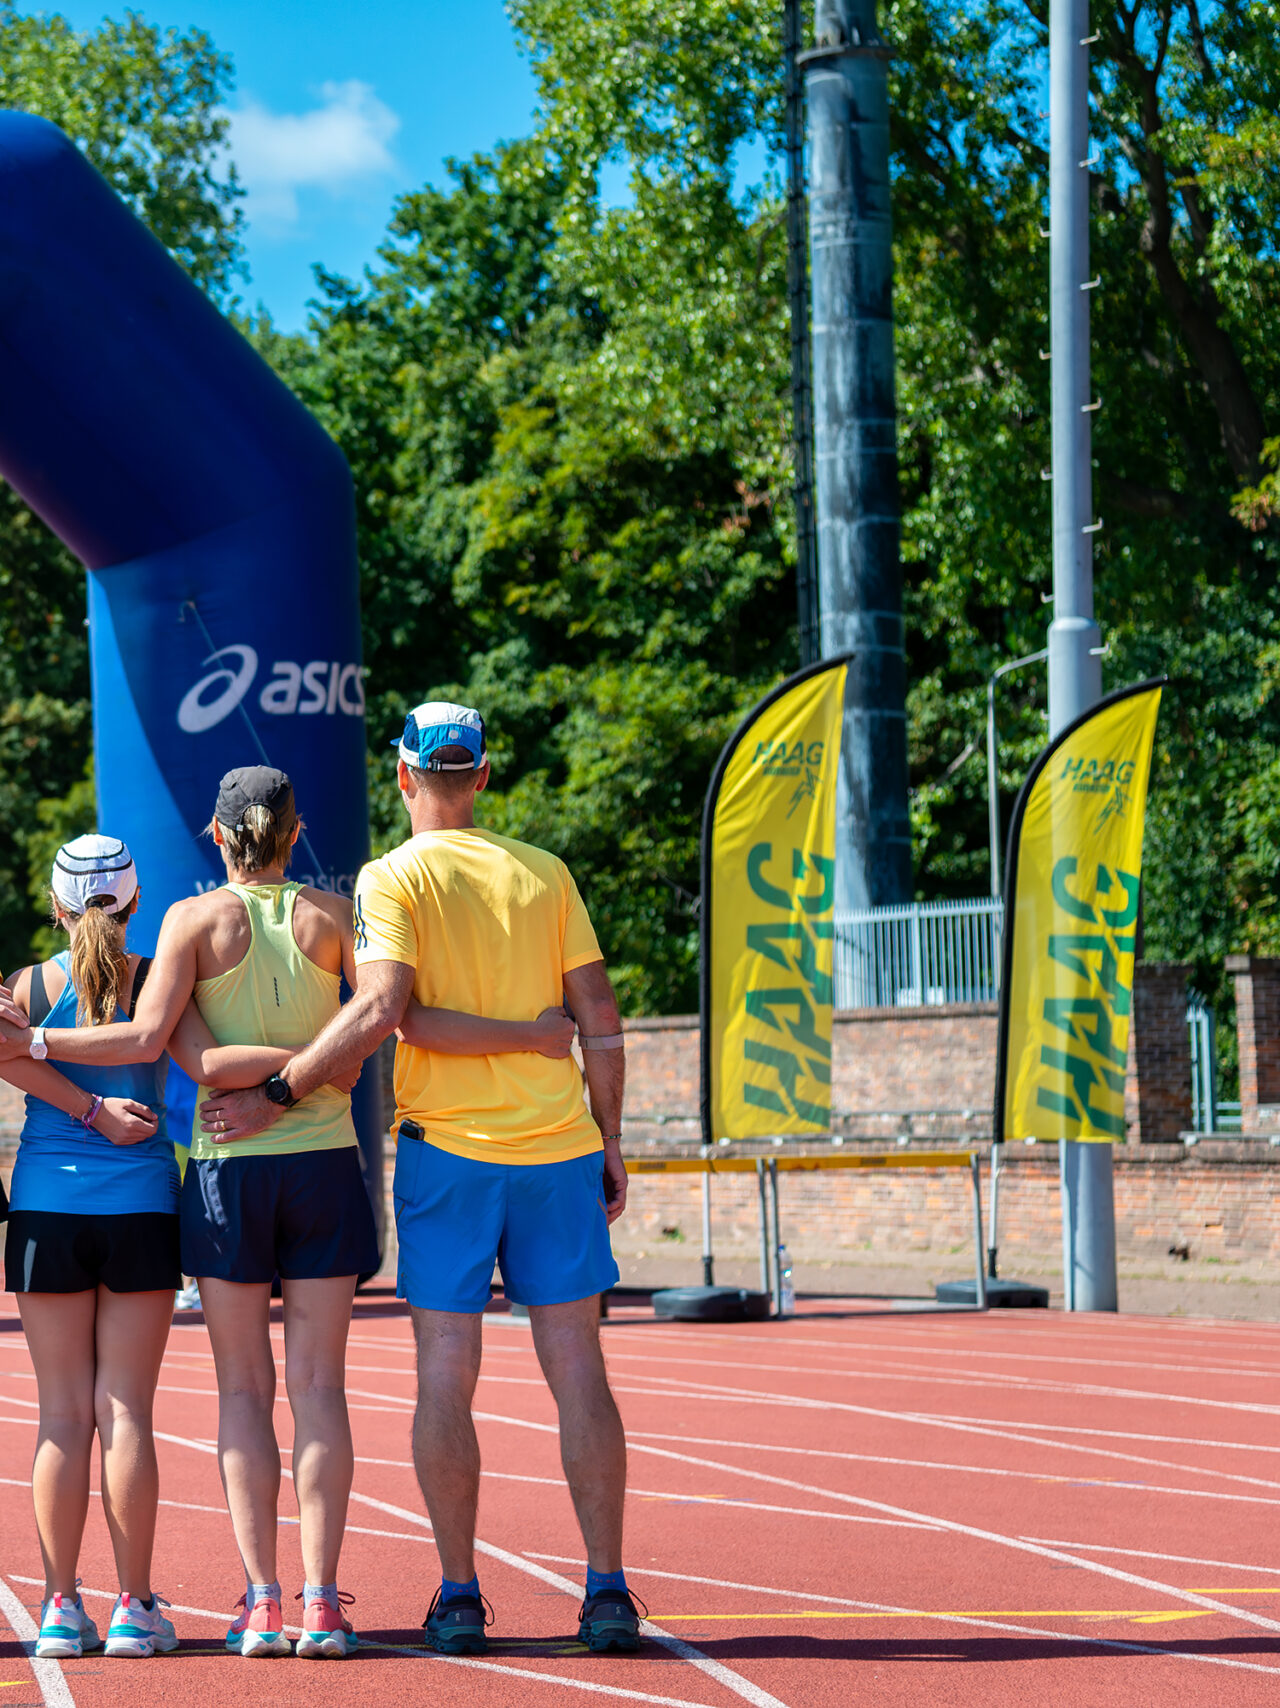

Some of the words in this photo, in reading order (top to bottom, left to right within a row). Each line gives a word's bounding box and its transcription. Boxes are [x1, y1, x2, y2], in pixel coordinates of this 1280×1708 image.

[259, 661, 366, 717] asics
[752, 741, 824, 765] HAAG
[1060, 757, 1136, 784] HAAG
[743, 842, 834, 1128] HAAG
[1036, 856, 1140, 1141] HAAG
